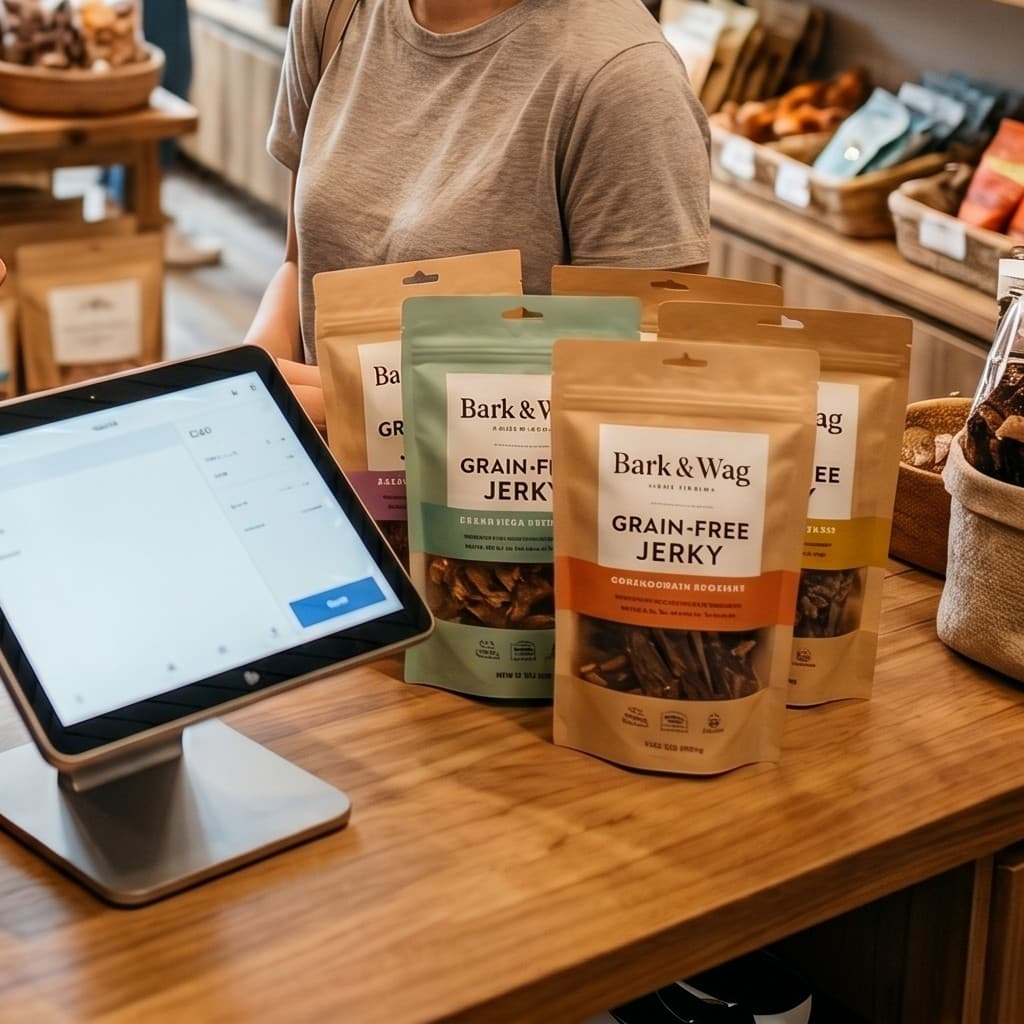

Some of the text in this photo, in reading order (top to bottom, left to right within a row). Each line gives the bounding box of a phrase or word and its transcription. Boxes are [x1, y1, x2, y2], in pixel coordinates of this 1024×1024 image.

[373, 365, 401, 387] Ba
[460, 396, 515, 420] Bark
[519, 399, 536, 420] &
[816, 411, 843, 435] ag
[460, 457, 553, 476] GRAIN-F
[613, 451, 752, 487] Bark & Wag
[612, 514, 750, 541] GRAIN-FREE
[636, 541, 724, 566] JERKY
